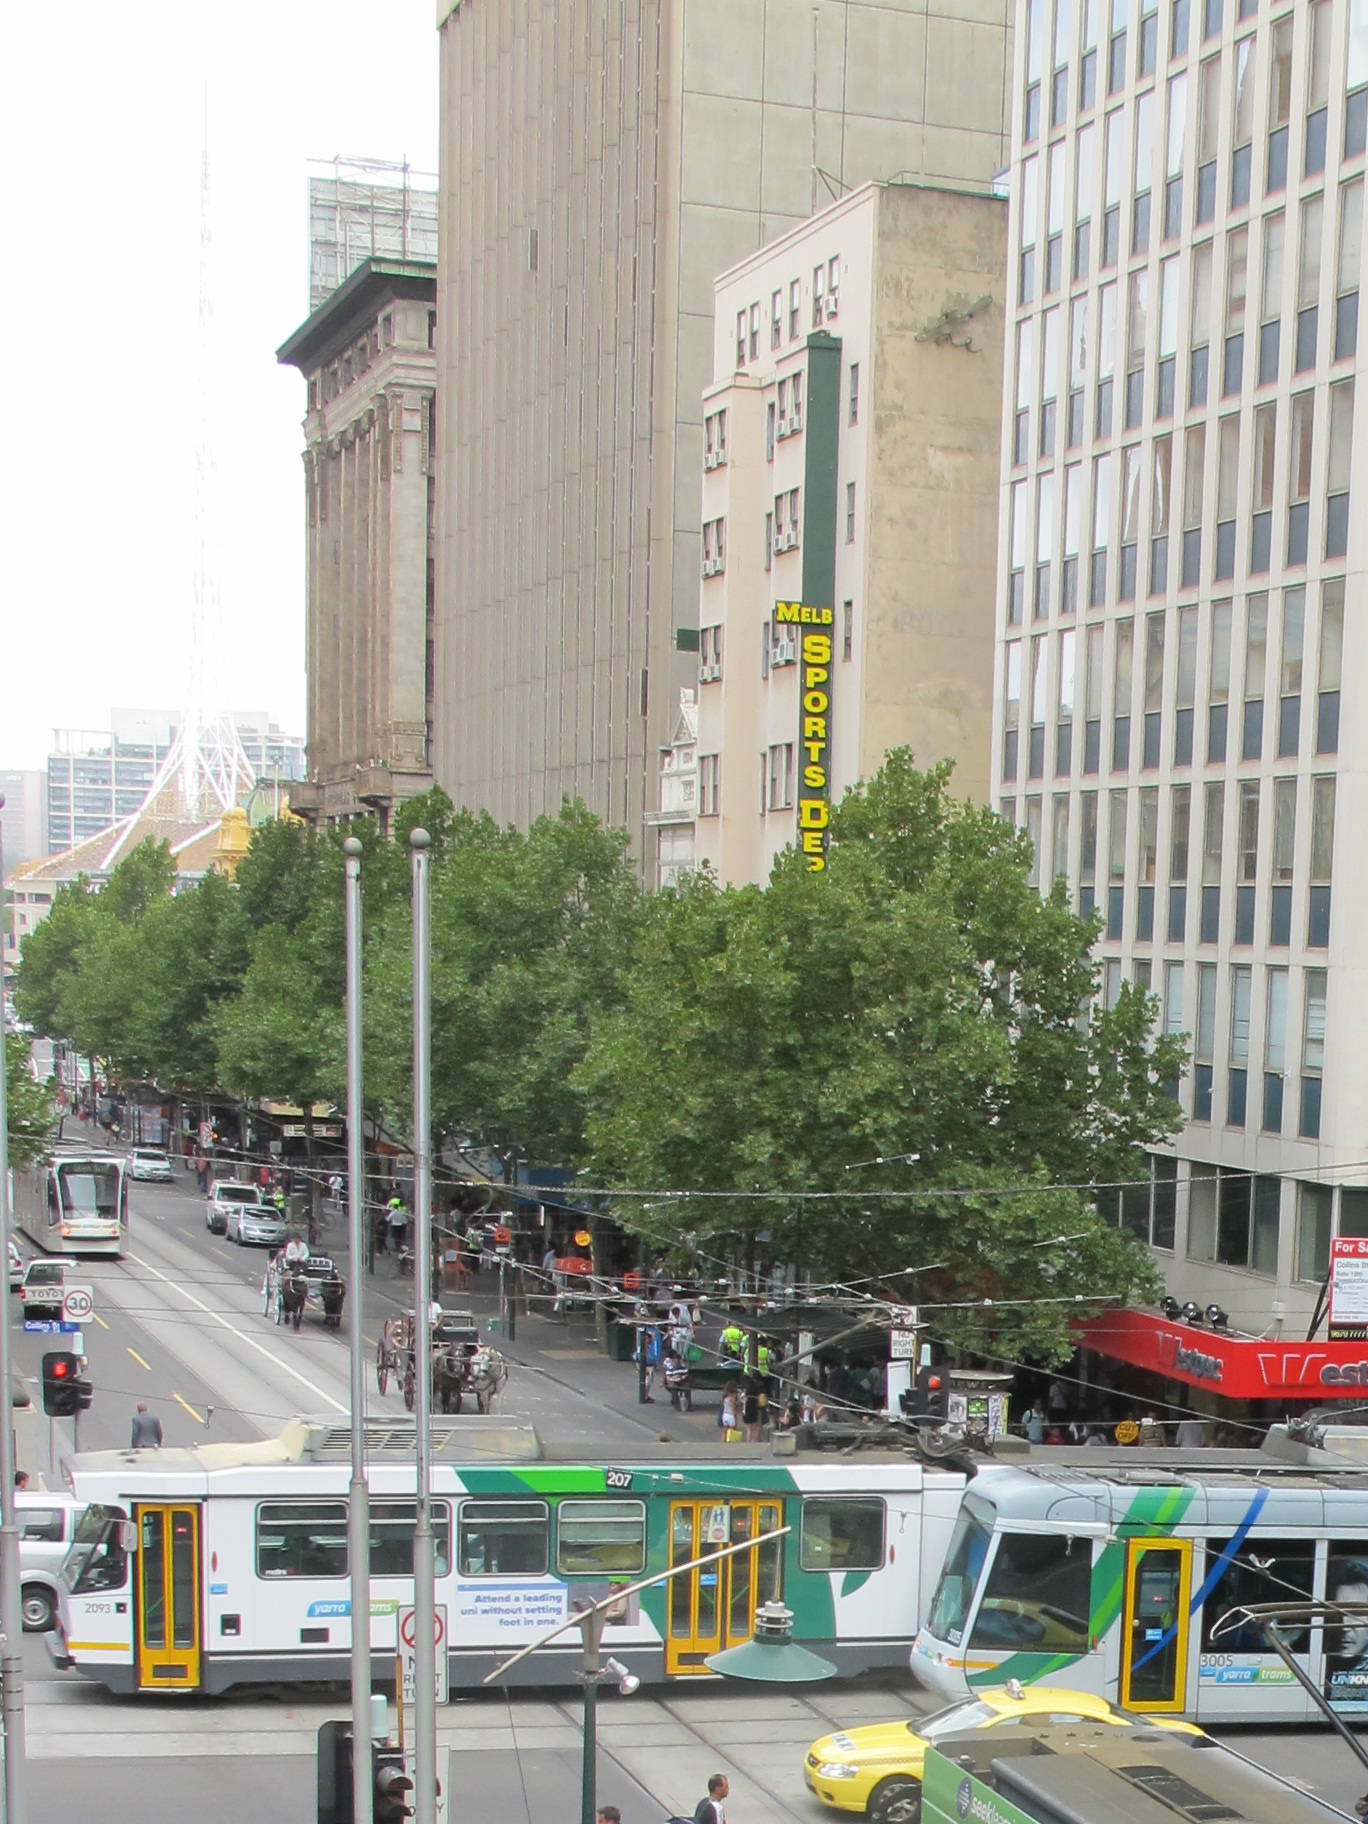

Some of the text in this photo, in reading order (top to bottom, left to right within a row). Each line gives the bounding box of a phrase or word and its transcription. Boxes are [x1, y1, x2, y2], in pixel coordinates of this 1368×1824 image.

[776, 602, 833, 625] MELB
[803, 634, 831, 789] SPORTS
[1335, 1241, 1354, 1252] For
[1336, 1261, 1359, 1269] Collins
[29, 1290, 63, 1298] TOYO
[69, 1297, 89, 1310] 30
[606, 1472, 632, 1487] 207
[475, 1594, 511, 1603] Attend
[523, 1593, 563, 1605] leading
[85, 1603, 111, 1614] 2093
[314, 1603, 346, 1615] yarra
[461, 1605, 562, 1616] uni without setting
[499, 1618, 521, 1627] foot
[524, 1618, 534, 1626] in
[1201, 1654, 1233, 1667] 3005
[404, 1673, 441, 1684] RIT
[1222, 1670, 1293, 1682] yarra trams
